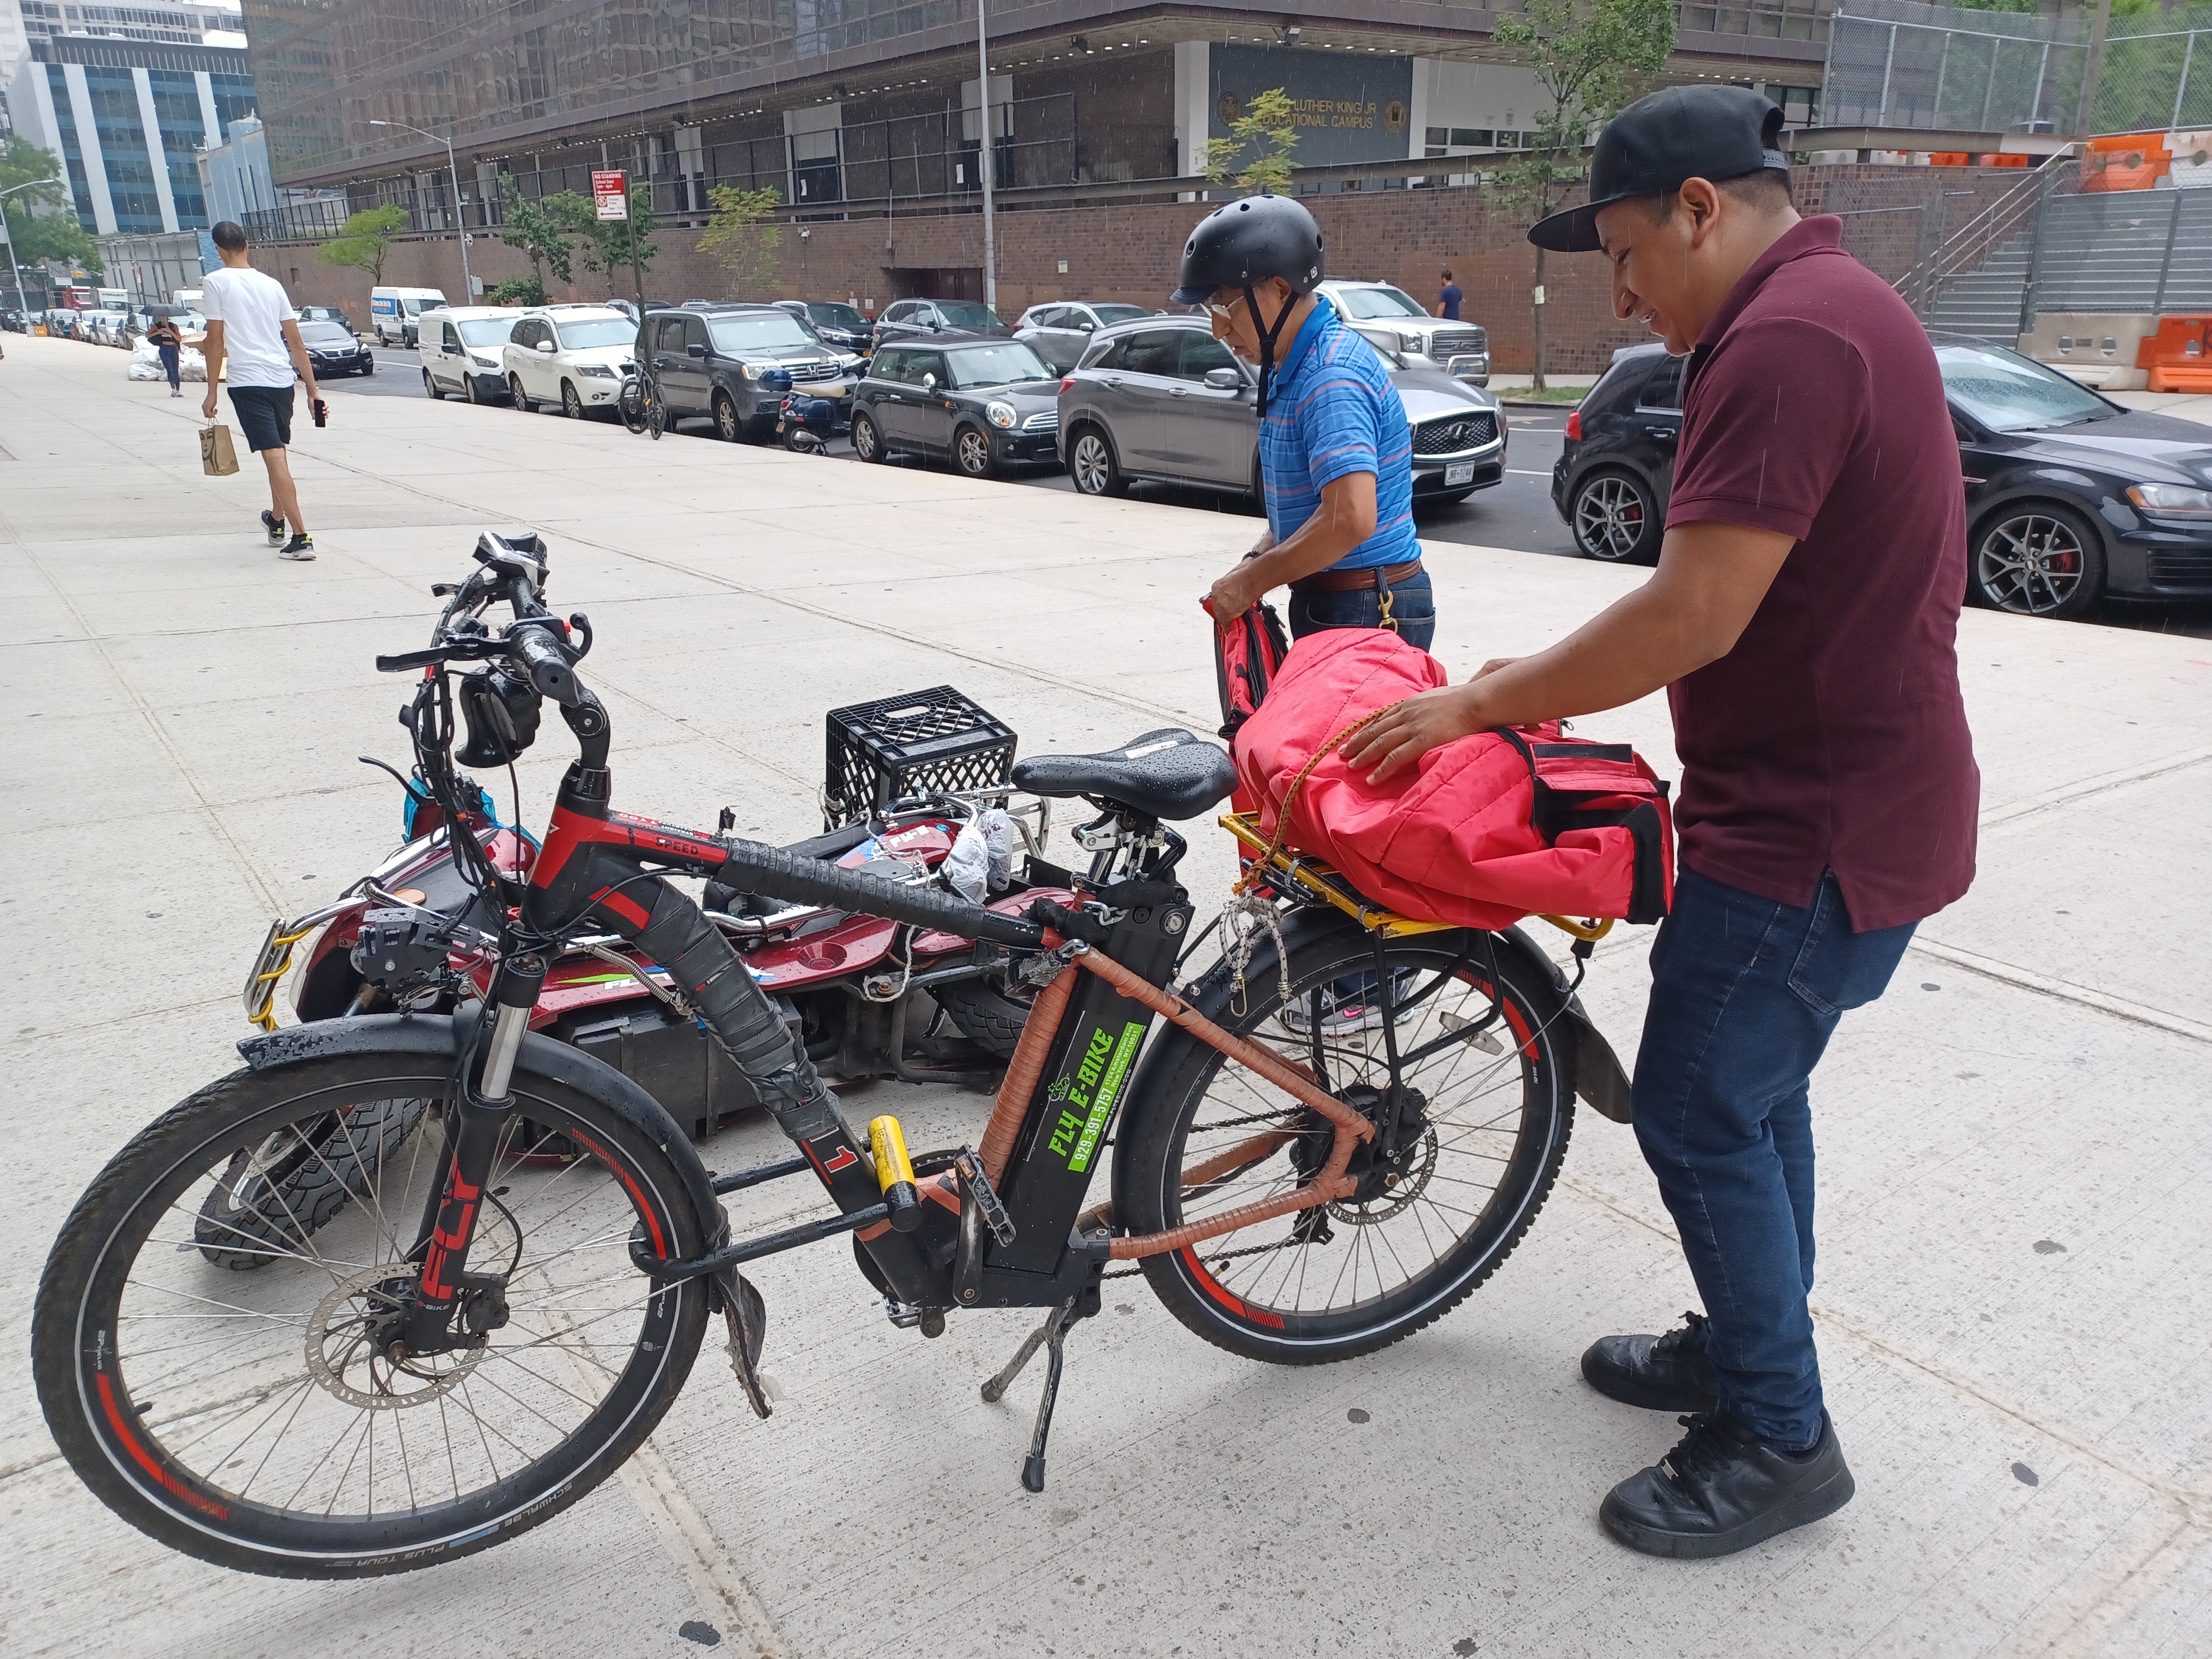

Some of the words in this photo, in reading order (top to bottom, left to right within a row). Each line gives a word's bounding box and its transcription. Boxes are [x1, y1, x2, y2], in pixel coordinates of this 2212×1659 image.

[1294, 99, 1333, 112] LUTHER
[1337, 101, 1361, 114] KING
[1364, 102, 1376, 115] JR
[1259, 113, 1327, 127] DUCATIONAL
[1331, 115, 1373, 129] CAMPUS
[655, 837, 698, 855] SPEED
[1110, 1074, 1120, 1087] New
[1123, 1048, 1131, 1058] NY
[1127, 1031, 1138, 1047] 10031
[1111, 1037, 1129, 1071] Amsterdam
[1048, 1110, 1084, 1157] FLY
[1068, 1027, 1114, 1109] E-BIKE
[1074, 1087, 1113, 1161] 929-391-5757
[504, 1482, 572, 1527] SCHWALBE
[357, 1555, 397, 1567] TOUR
[403, 1543, 445, 1560] PLUS
